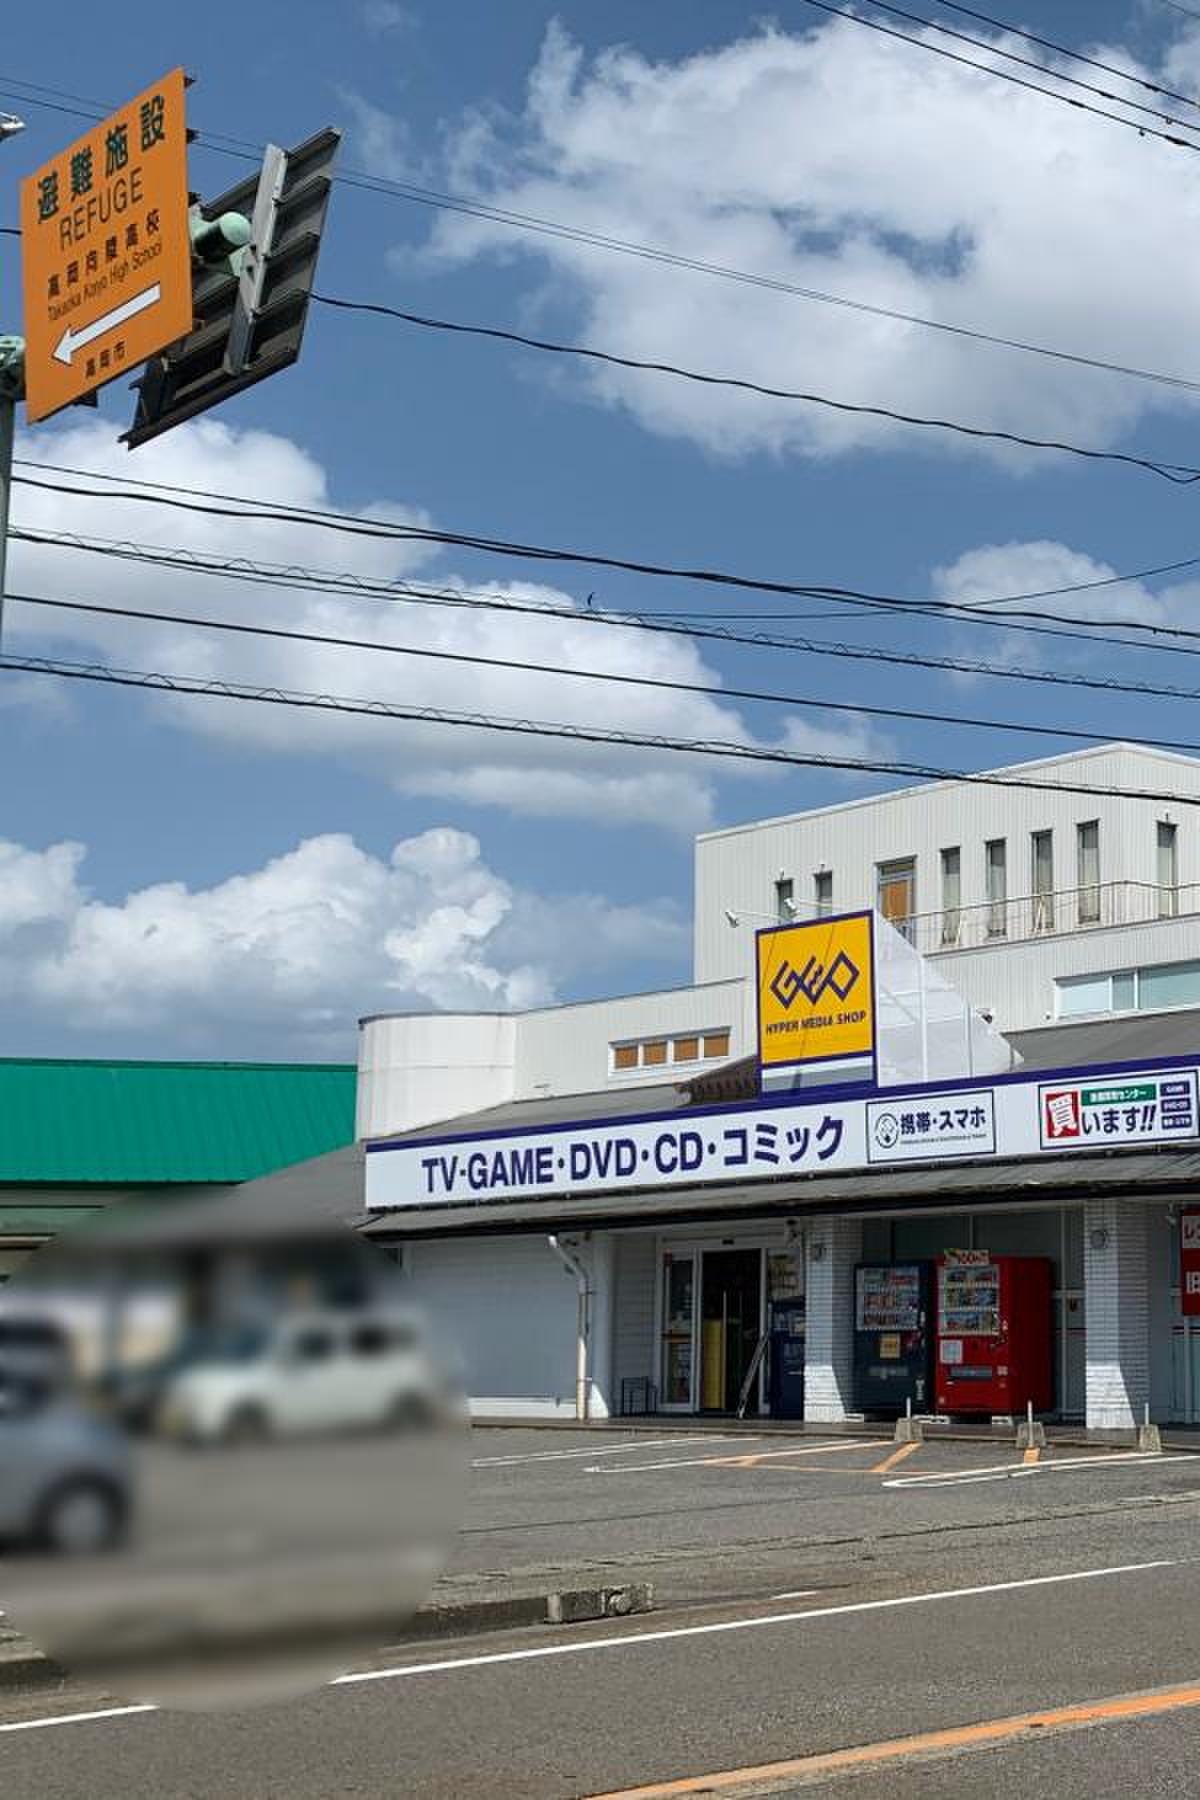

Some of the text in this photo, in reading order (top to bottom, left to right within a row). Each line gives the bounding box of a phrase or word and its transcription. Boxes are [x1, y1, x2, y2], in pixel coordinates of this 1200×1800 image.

[38, 95, 165, 224] 避難施設
[59, 166, 143, 250] REFUGE
[769, 950, 860, 1010] GEO
[766, 1010, 867, 1035] HYPER MEDIA SHOP
[900, 1105, 987, 1136] 携帯・スマホ
